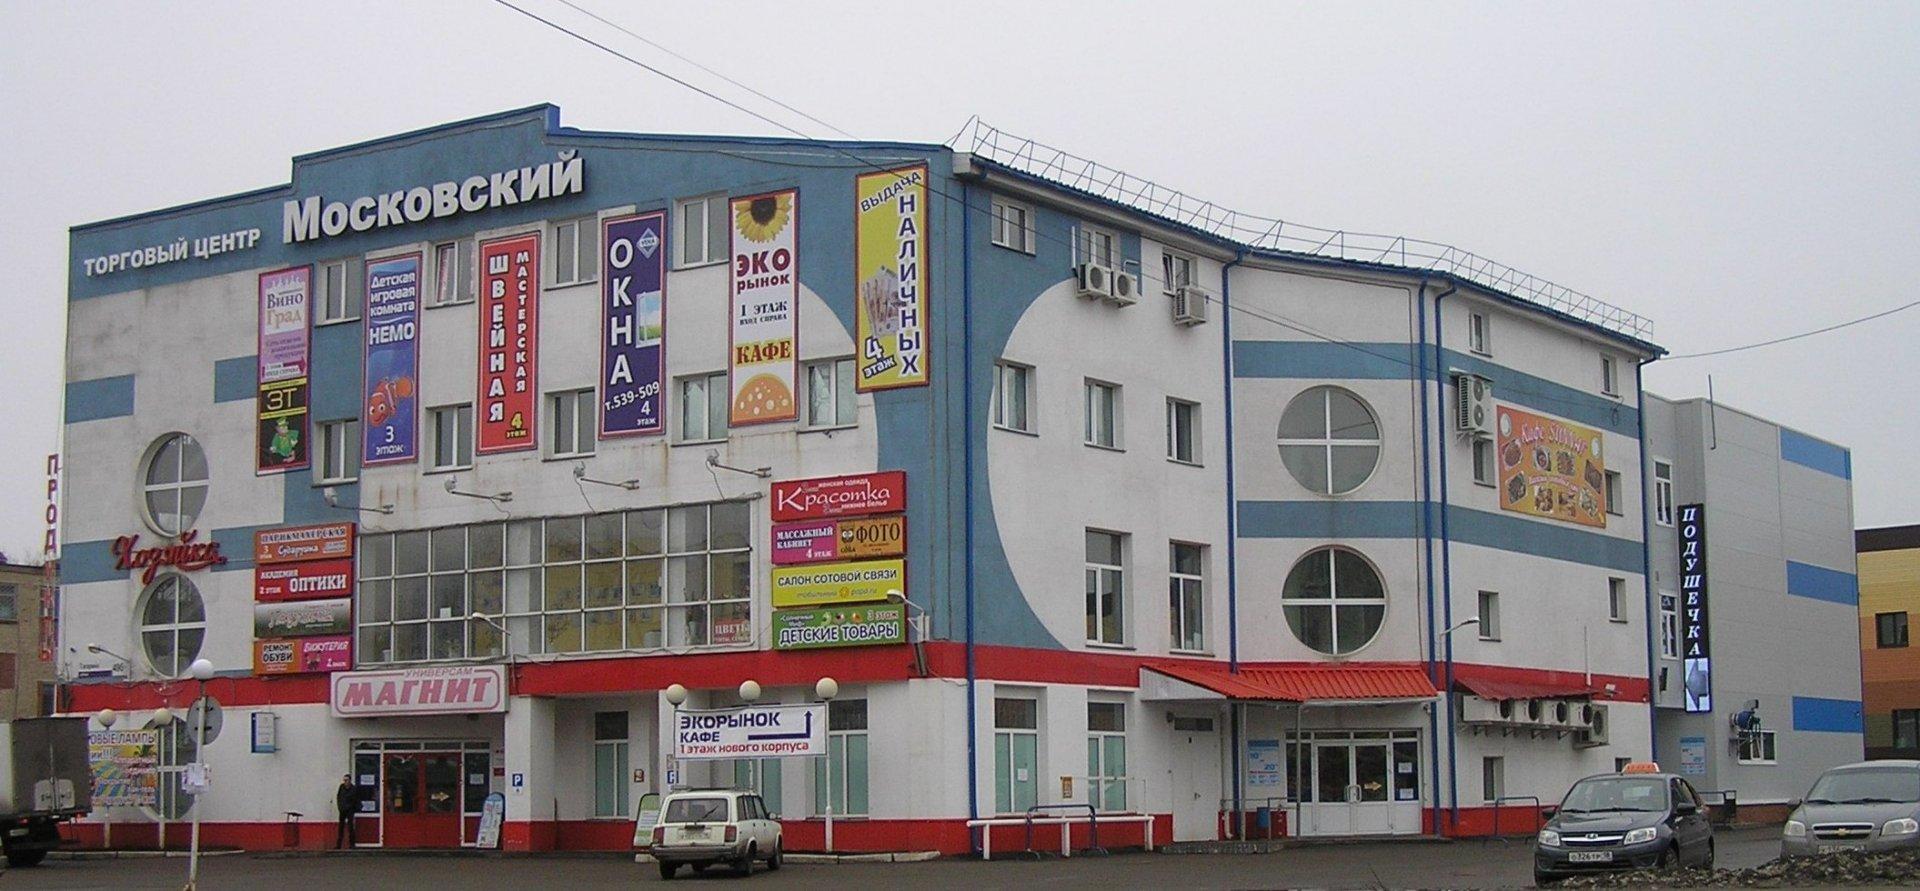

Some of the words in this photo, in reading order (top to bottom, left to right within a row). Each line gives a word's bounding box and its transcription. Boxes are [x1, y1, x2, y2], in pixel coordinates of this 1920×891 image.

[283, 149, 584, 243] Московский
[860, 171, 922, 213] ВЫДАЧА
[84, 235, 189, 277] ТОРГОВЫЙ
[194, 228, 261, 258] ЦЕНТР
[736, 248, 791, 277] ЭКО
[371, 271, 416, 289] Детская
[737, 274, 790, 295] рынок
[898, 194, 921, 376] НАЛИЧНЫХ
[266, 291, 304, 310] Вино
[370, 287, 416, 304] игровая
[370, 301, 416, 317] комната
[609, 238, 634, 386] ОКНА
[753, 300, 788, 316] ЭТАЖ
[266, 309, 303, 329] Град
[515, 251, 530, 392] МАСТЕРСКАЯ
[369, 322, 416, 346] НЕМО
[488, 254, 509, 422] ШВЕЙНАЯ
[736, 340, 791, 365] КАФЕ
[864, 337, 884, 363] 4
[862, 357, 897, 377] этаж
[604, 380, 660, 413] т.539-509
[641, 400, 652, 416] 4
[511, 412, 523, 429] 4
[385, 426, 395, 443] 3
[375, 442, 404, 456] этаж
[777, 481, 891, 512] Красотка
[777, 525, 834, 541] МАССАЖНЫЙ
[855, 522, 901, 544] ФОТО
[777, 538, 814, 550] КАБИНЕТ
[806, 548, 813, 559] 4
[111, 528, 229, 586] Хозяйка
[289, 573, 347, 593] ОПТИКИ
[778, 573, 812, 587] САЛОН
[814, 570, 862, 585] СОТОВОЙ
[864, 568, 898, 582] СВЯЗИ
[1682, 507, 1702, 657] ПОДУШЕЧКА
[780, 626, 839, 645] ДЕТСКИЕ
[842, 623, 898, 640] ТОВАРЫ
[262, 652, 294, 663] ОБУВИ
[263, 643, 294, 652] РЕМОНТ
[404, 667, 474, 679] УНИВЕРСАМ
[342, 677, 492, 707] МАГНИТ
[680, 711, 781, 730] ЭКОРЫНОК
[680, 731, 721, 743] КАФЕ
[686, 743, 717, 755] этаж
[718, 743, 760, 753] нового
[761, 741, 810, 753] корпуса
